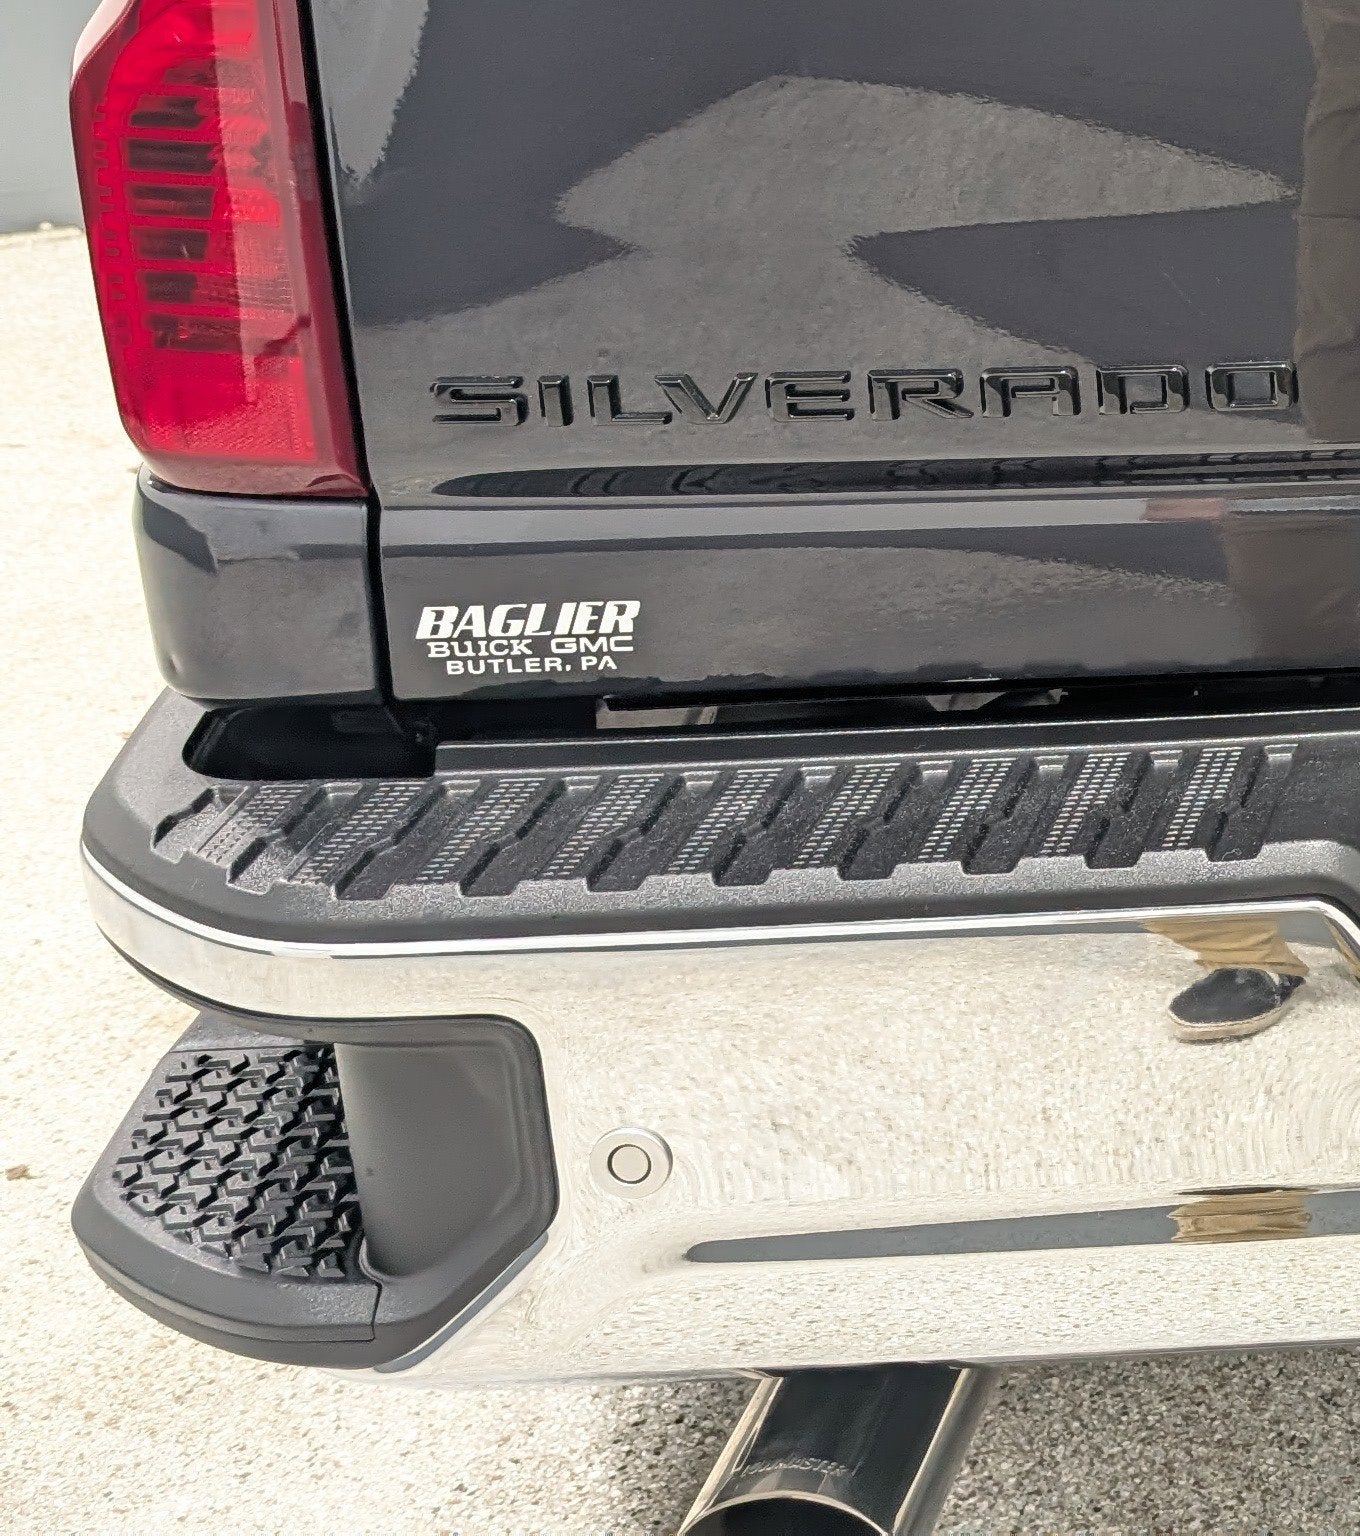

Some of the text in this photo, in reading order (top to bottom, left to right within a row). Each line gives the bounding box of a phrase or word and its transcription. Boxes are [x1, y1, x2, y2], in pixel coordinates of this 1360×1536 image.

[430, 361, 1300, 428] SILVERADO
[415, 600, 641, 640] BAGLIER
[427, 635, 634, 658] BUICK GMC
[446, 655, 618, 675] BUTLER, PA
